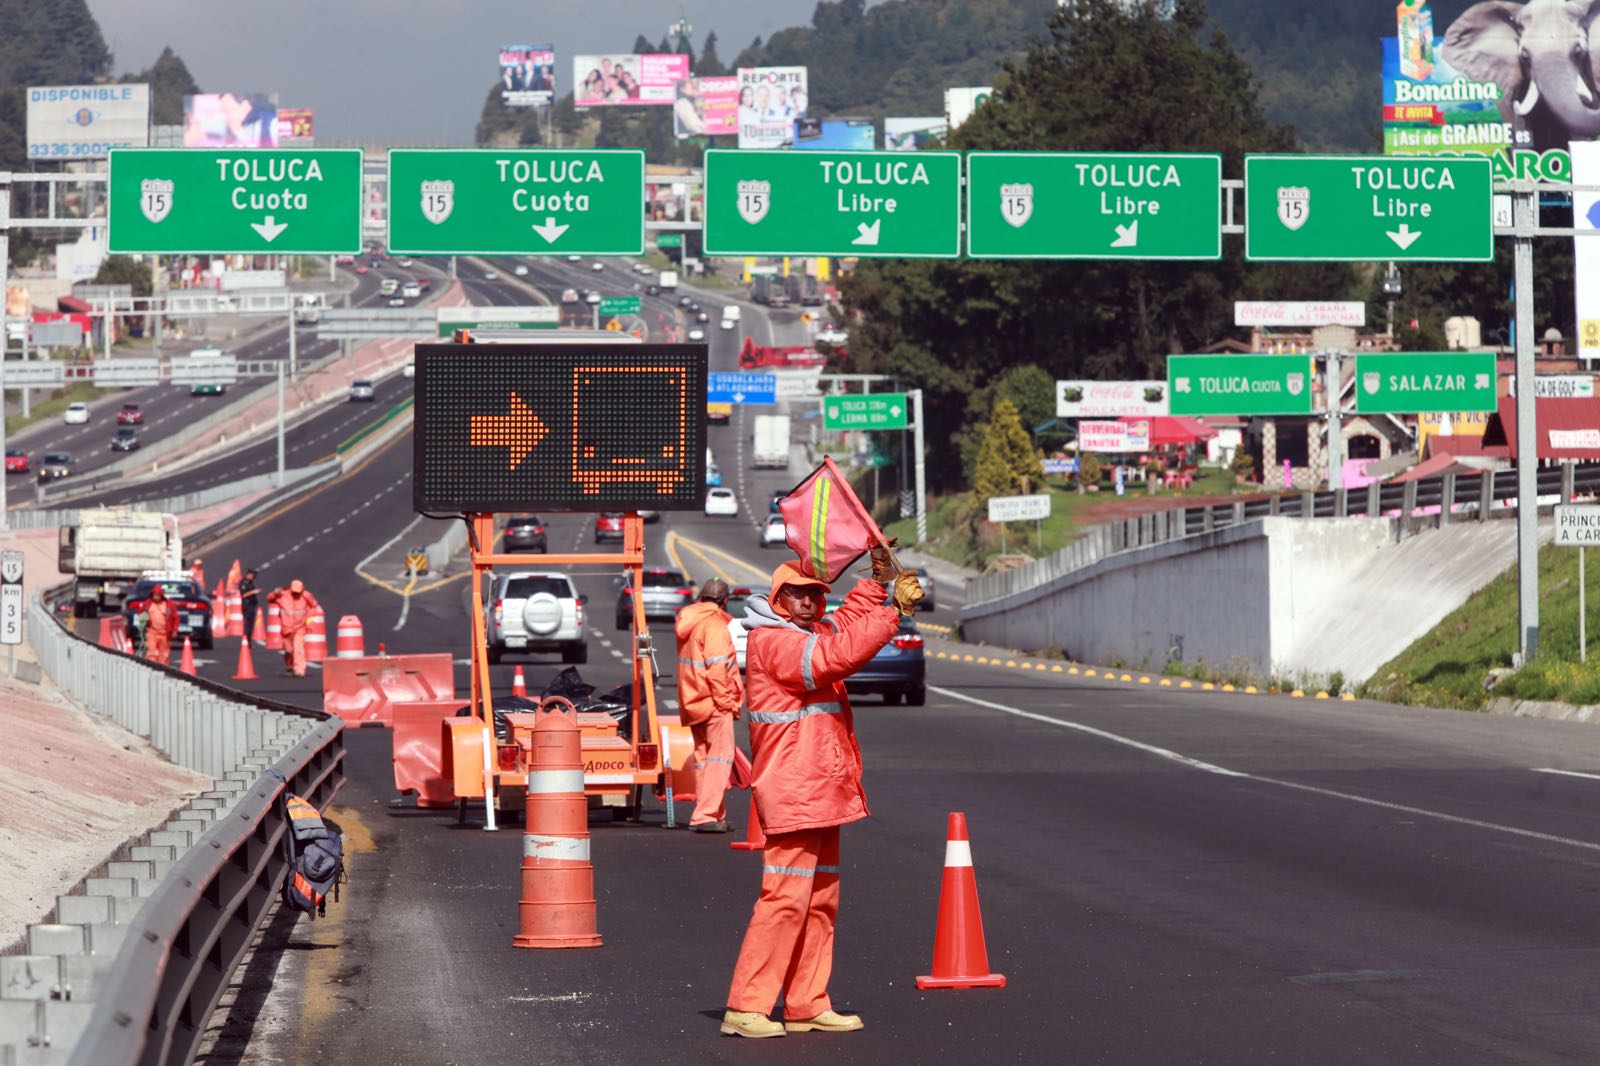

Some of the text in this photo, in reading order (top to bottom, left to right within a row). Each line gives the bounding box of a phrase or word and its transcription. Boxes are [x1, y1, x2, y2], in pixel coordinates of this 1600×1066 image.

[742, 72, 802, 84] REPORTE
[31, 88, 132, 102] DISPONIBLE
[1393, 80, 1498, 101] Bonafina
[1394, 107, 1434, 119] TE INVITA
[1424, 130, 1438, 146] de
[1441, 123, 1513, 146] GRANDE
[1515, 130, 1530, 143] es
[216, 159, 323, 182] TOLUCA
[496, 160, 604, 183] TOLUCA
[820, 161, 930, 185] TOLUCA
[1075, 164, 1182, 188] TOLUCA
[1351, 167, 1456, 190] TOLUCA
[148, 194, 165, 212] 15
[231, 186, 308, 210] Cuota
[428, 195, 446, 213] 15
[512, 189, 589, 212] Cuota
[745, 195, 762, 213] 15
[837, 189, 897, 213] Libre
[1008, 198, 1025, 216] 15
[1100, 192, 1160, 215] Libre
[1372, 195, 1432, 217] Libre
[1285, 201, 1302, 219] 15
[1305, 302, 1347, 312] CABAÑA
[1292, 313, 1360, 321] LAS TRUCHAS
[1200, 376, 1281, 393] TOLUCA CUOTA
[1389, 374, 1466, 391] SALAZAR
[1562, 530, 1570, 541] A
[7, 563, 17, 574] 15
[4, 588, 20, 596] km
[7, 604, 15, 617] 3
[7, 621, 16, 634] 5
